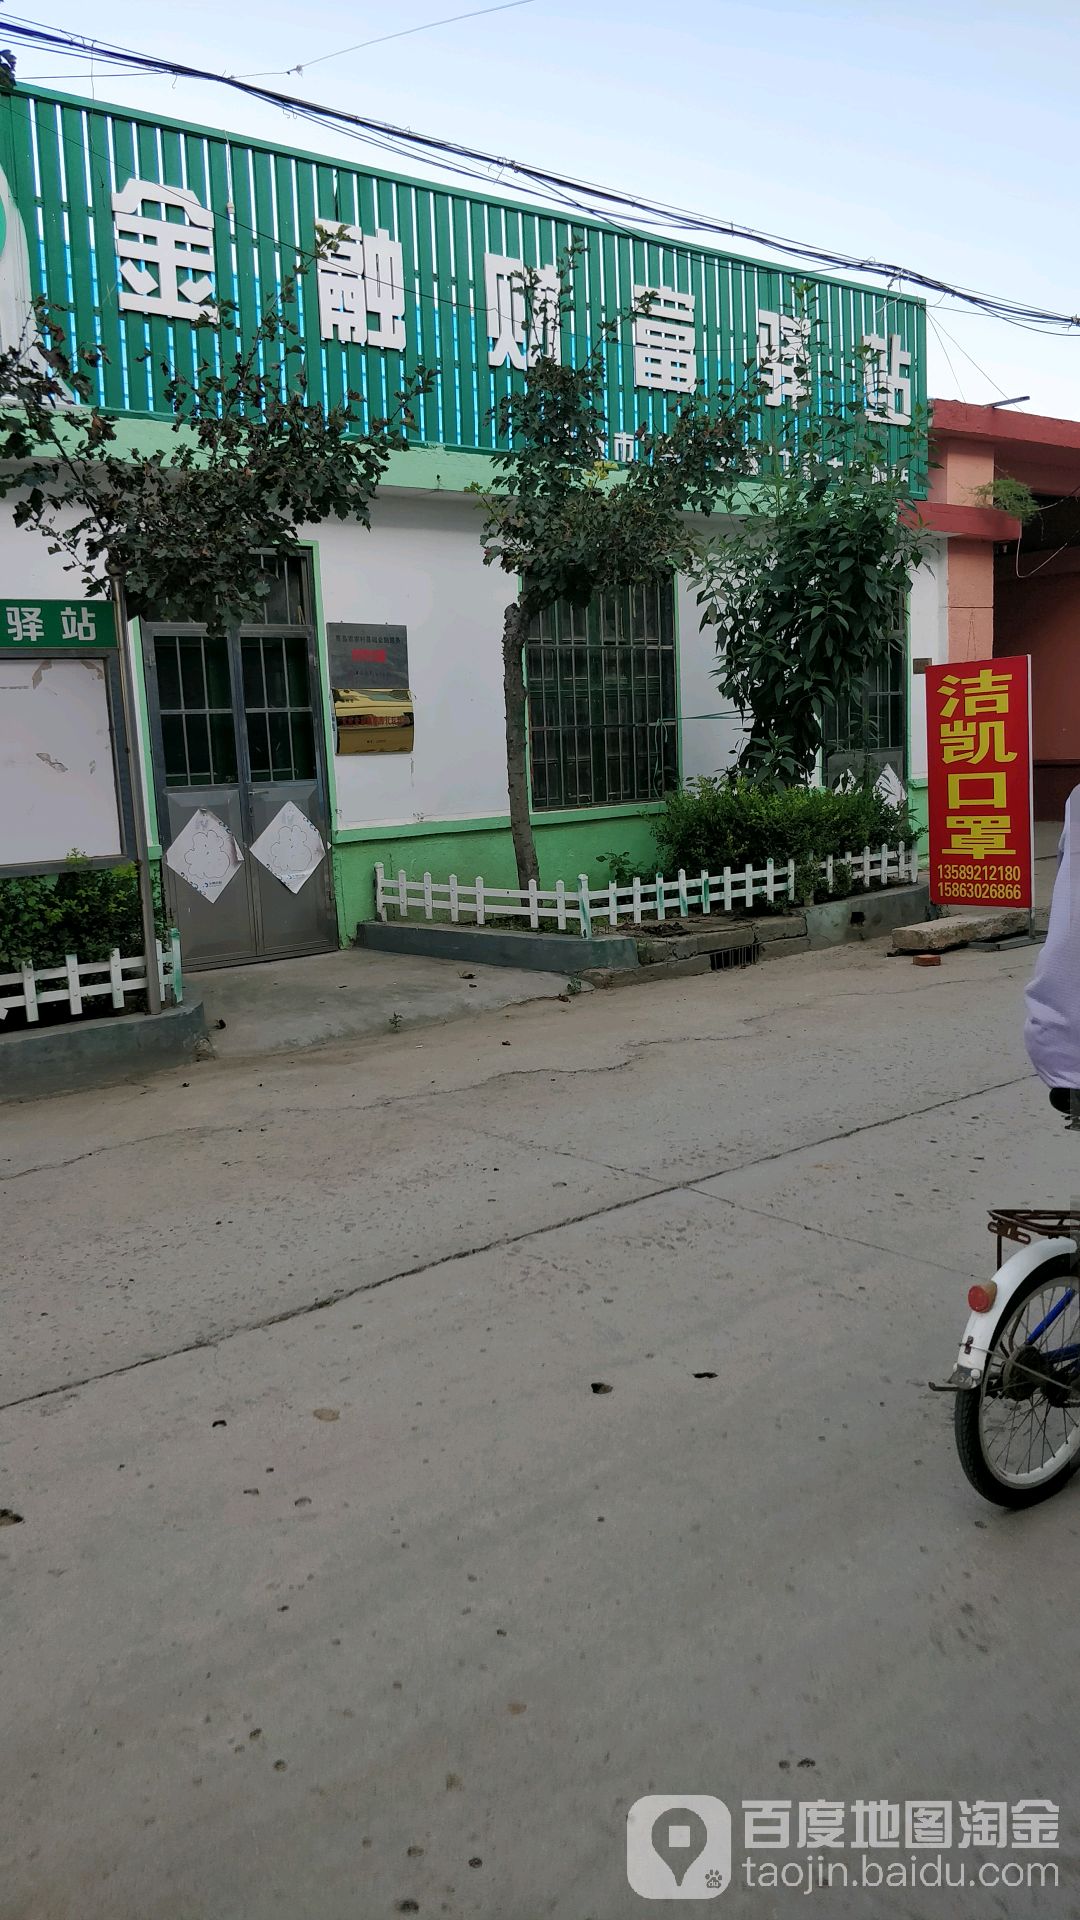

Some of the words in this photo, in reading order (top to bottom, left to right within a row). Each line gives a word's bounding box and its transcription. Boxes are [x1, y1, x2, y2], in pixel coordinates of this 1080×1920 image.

[111, 178, 911, 426] 金融财富驿站
[5, 606, 96, 641] 驿站
[937, 669, 1018, 860] 洁凯口罩
[937, 864, 1021, 882] 13589212180
[938, 882, 1021, 900] 15863026866
